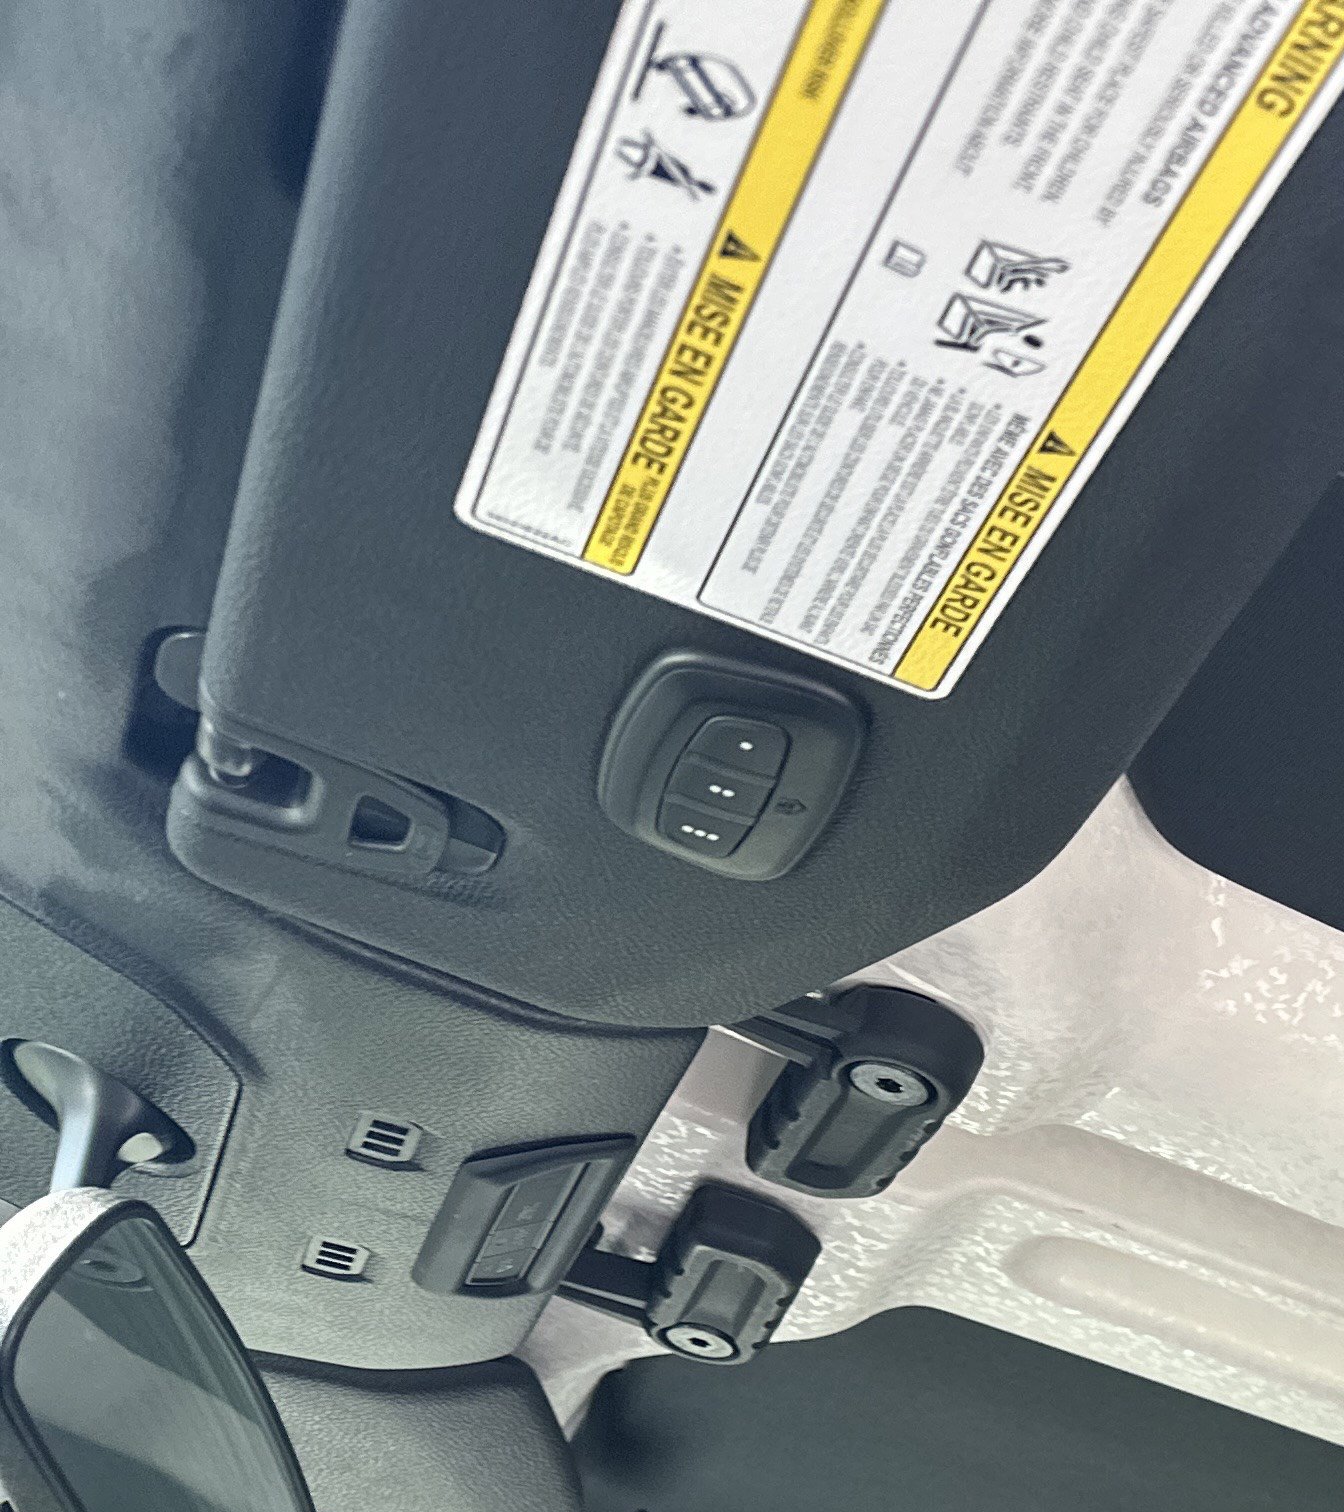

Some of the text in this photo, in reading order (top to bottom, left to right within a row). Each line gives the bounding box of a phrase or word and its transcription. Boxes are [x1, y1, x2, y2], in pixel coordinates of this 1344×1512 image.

[1140, 1, 1280, 207] ADVANCED AIRBAGS
[631, 272, 744, 475] MISE EN GARDE
[965, 474, 994, 500] DES
[979, 444, 1012, 478] AVEC
[948, 497, 980, 529] SACS
[997, 464, 1059, 526] MISE
[910, 526, 962, 593] GONFLABLES
[974, 522, 1022, 562] EN
[927, 558, 999, 638] GARDE
